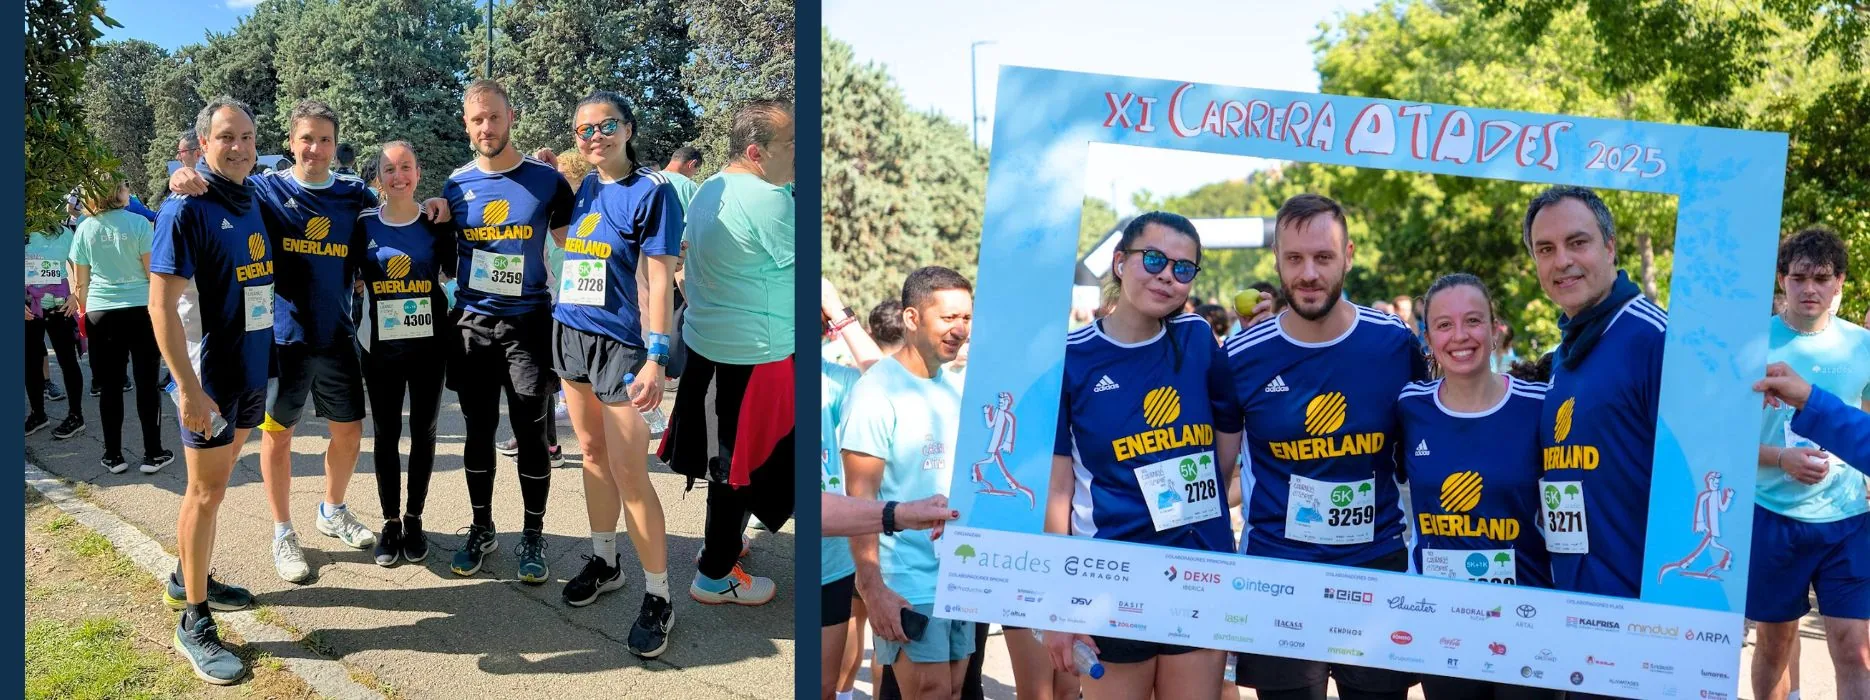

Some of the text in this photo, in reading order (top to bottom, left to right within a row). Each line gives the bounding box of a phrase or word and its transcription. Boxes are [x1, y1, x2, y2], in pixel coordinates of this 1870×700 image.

[1103, 82, 1668, 178] XI CARRERA ATADES 2025
[463, 224, 534, 242] ENERLAND
[282, 237, 349, 258] ENERLAND
[494, 258, 507, 268] 5K
[40, 269, 61, 278] 2589
[491, 269, 523, 285] 3259
[577, 278, 604, 292] 2728
[403, 313, 432, 327] 4300
[1112, 423, 1214, 462] ENERLAND
[1269, 432, 1385, 461] ENERLAND
[1181, 463, 1197, 478] 5K
[1185, 478, 1217, 504] 2728
[1332, 490, 1352, 503] 5K
[1545, 491, 1560, 505] 5K
[1328, 505, 1374, 527] 3259
[1548, 511, 1583, 532] 3271
[978, 550, 1052, 574] atades
[1083, 557, 1130, 572] CEOE
[1183, 570, 1221, 584] DEXIS
[1246, 577, 1295, 597] integra
[1071, 596, 1093, 606] DSV
[1118, 600, 1145, 609] DASIT
[1451, 606, 1486, 617] LABORAL
[1579, 618, 1621, 629] KALFRISA
[1695, 631, 1731, 645] ARPA
[1447, 657, 1460, 667] RT
